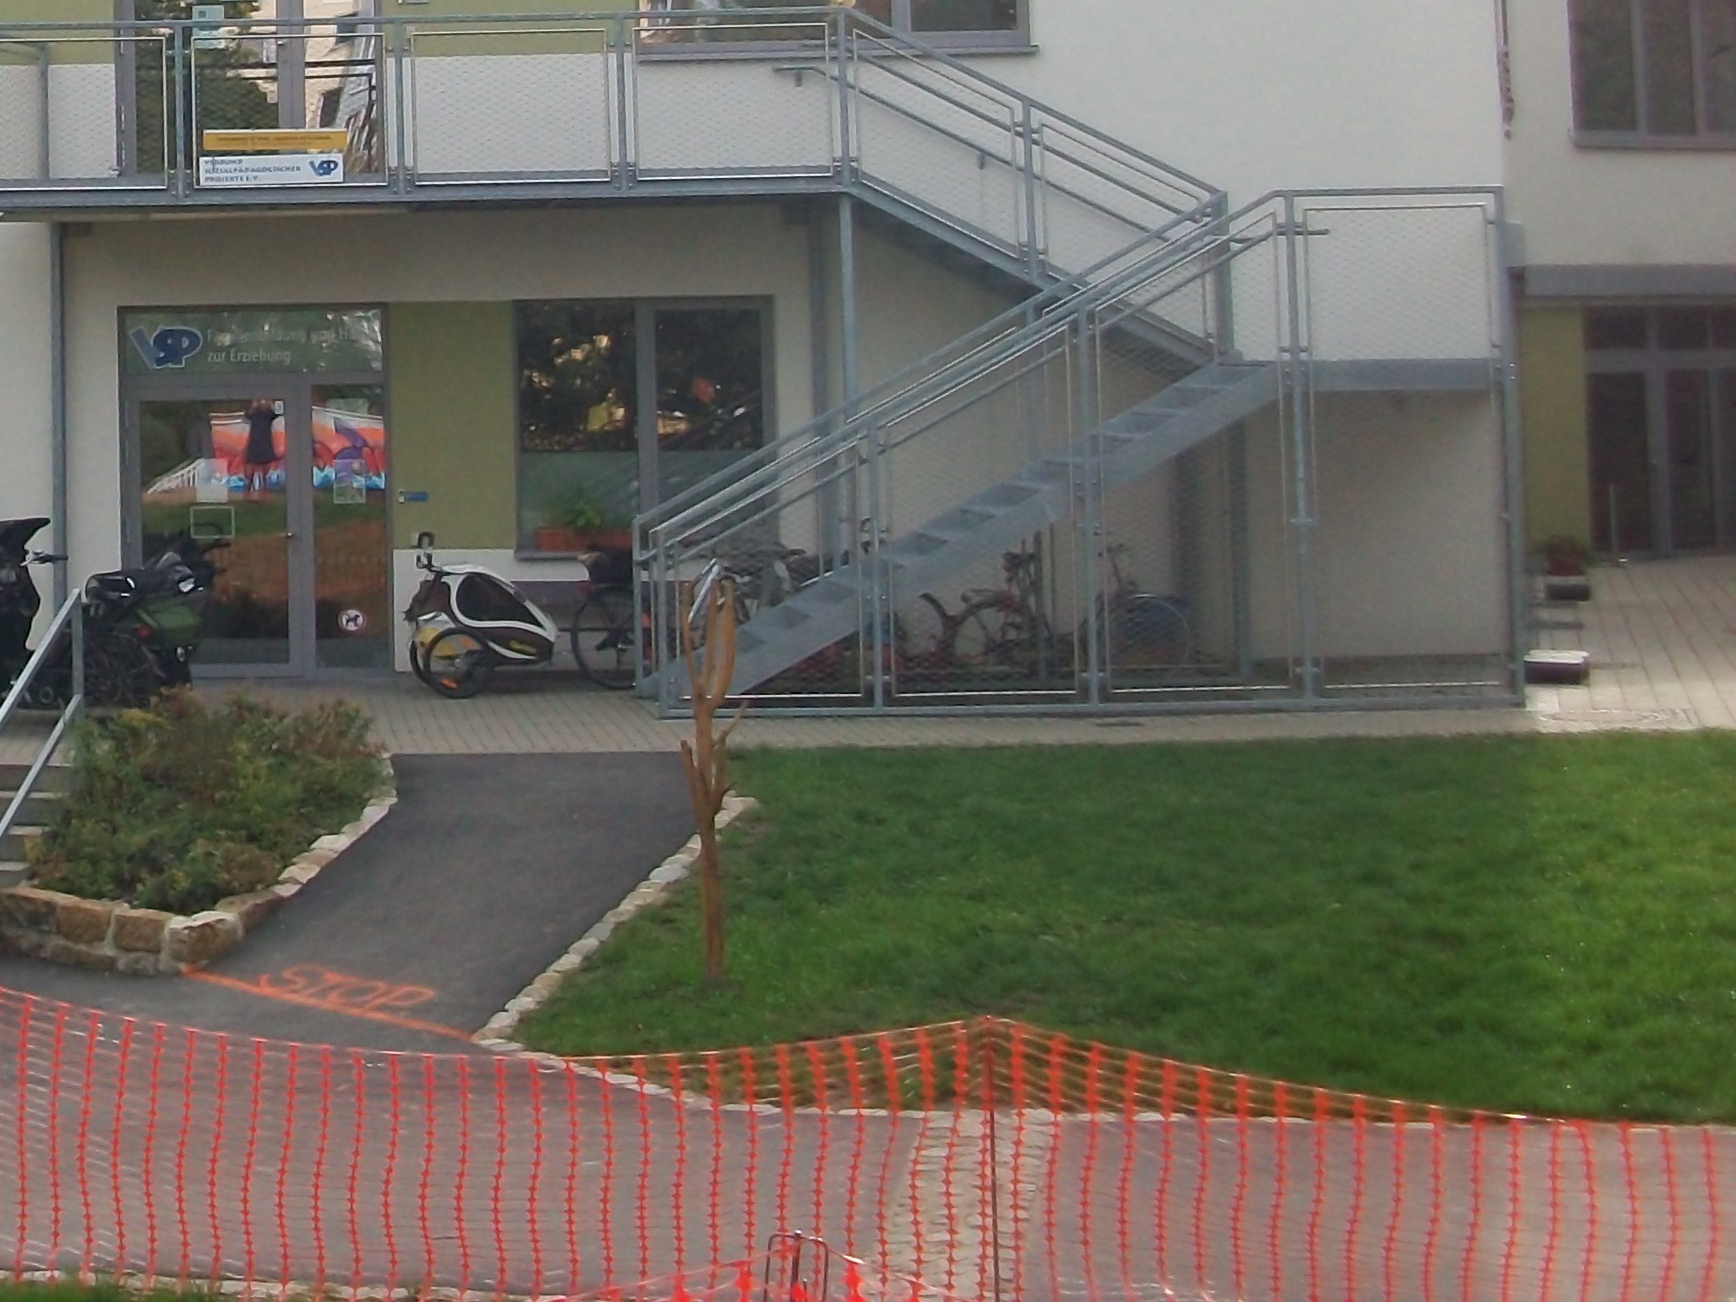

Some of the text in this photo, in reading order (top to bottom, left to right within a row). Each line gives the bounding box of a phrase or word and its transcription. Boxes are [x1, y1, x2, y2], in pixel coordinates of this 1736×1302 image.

[129, 325, 202, 369] VSP
[207, 349, 291, 365] zur Erziehung
[258, 964, 436, 1012] STOP
